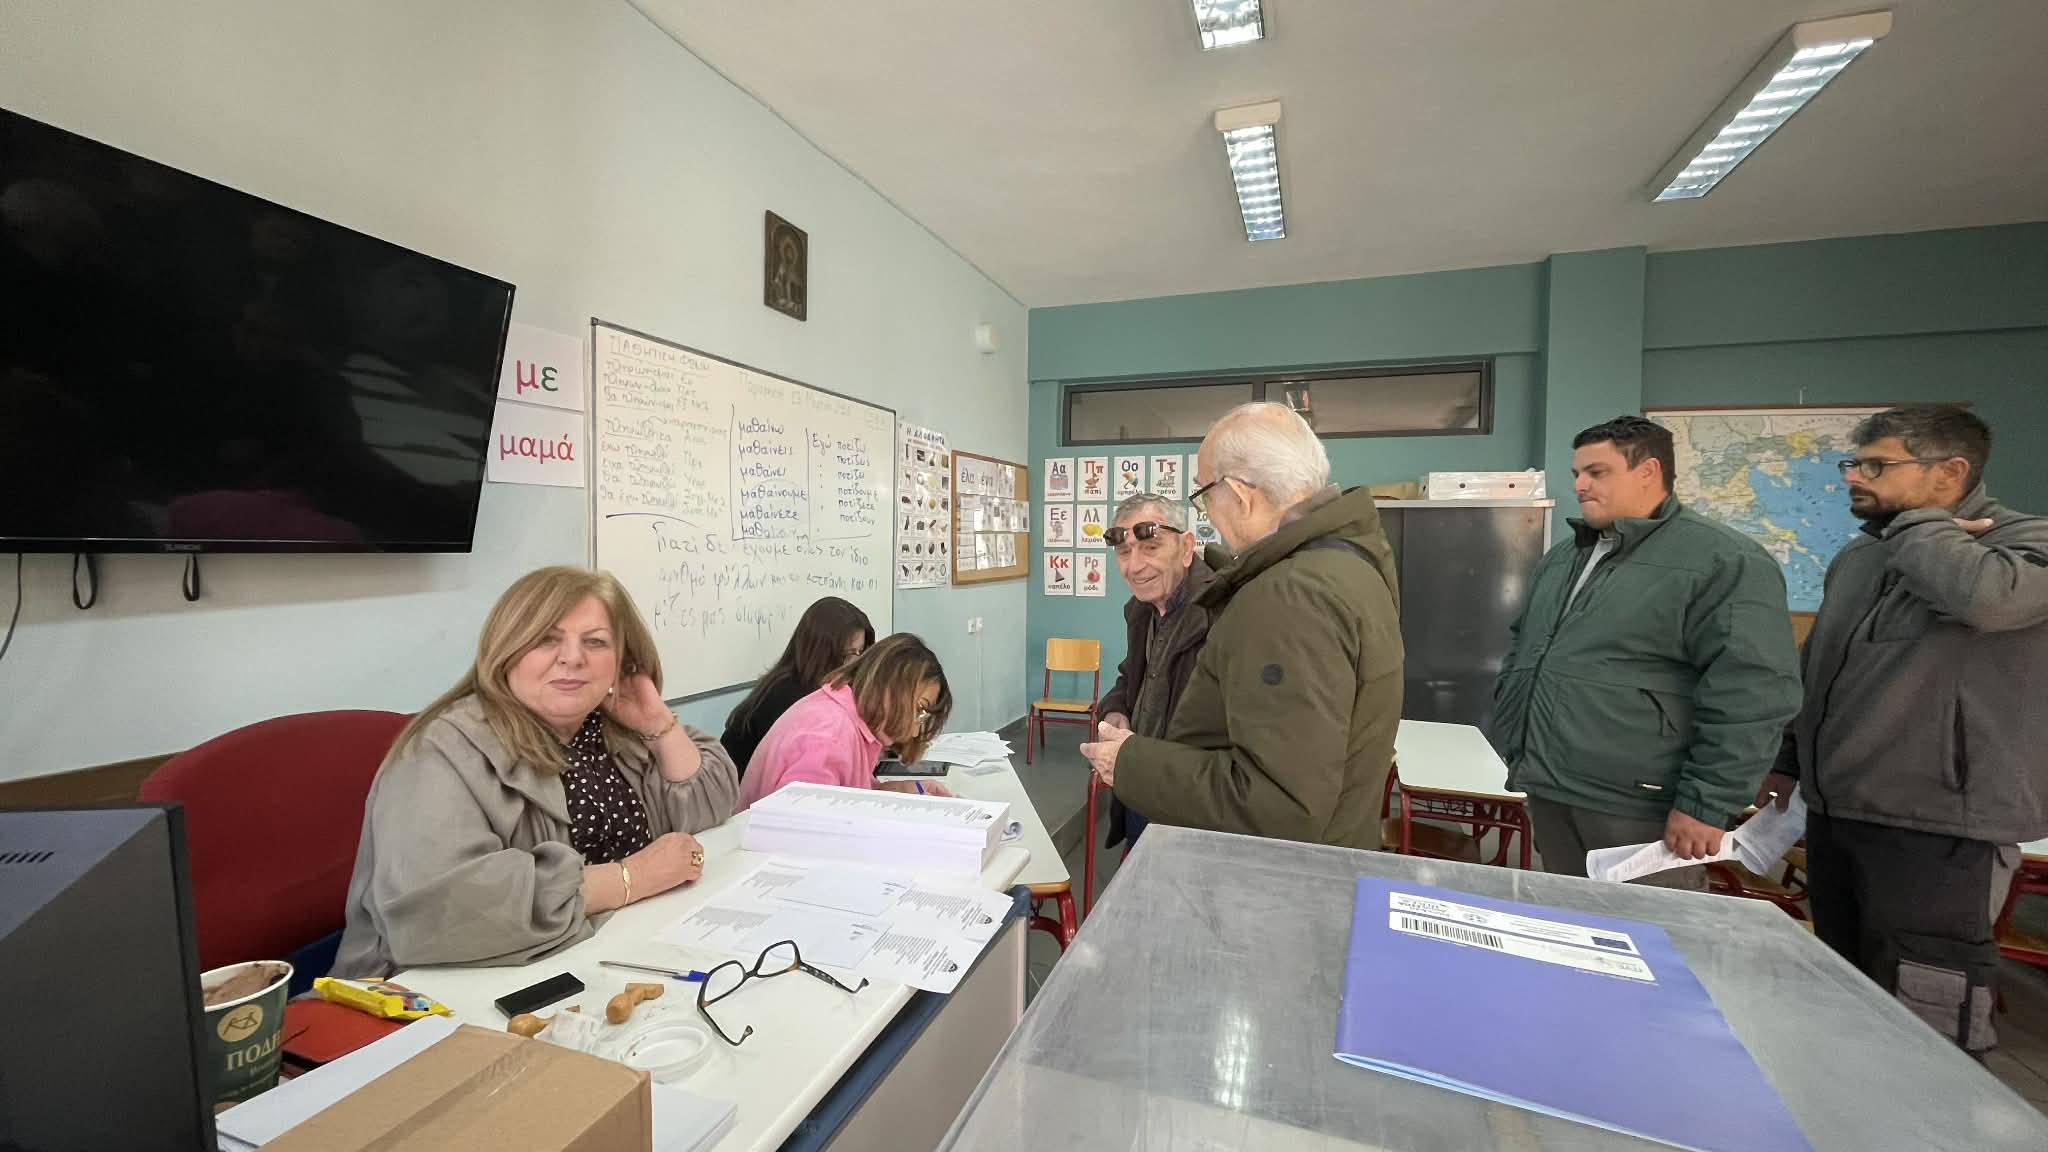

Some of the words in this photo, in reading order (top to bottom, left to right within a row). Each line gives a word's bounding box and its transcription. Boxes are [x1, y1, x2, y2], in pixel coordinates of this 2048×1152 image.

[516, 359, 559, 395] με
[738, 417, 785, 441] μαθαίνω
[500, 433, 574, 464] μαμά
[738, 440, 793, 461] μαθαίνεις
[740, 463, 787, 484] μαθαίνει
[1052, 462, 1066, 474] Αα
[1084, 460, 1104, 474] Ππ
[741, 485, 808, 507] μαθαίνουμε
[740, 504, 800, 525] μαθαίνετε
[1051, 507, 1067, 521] Εε
[1083, 508, 1100, 522] Λλ
[1050, 556, 1069, 569] Κκ
[1084, 556, 1098, 570] Ρρ
